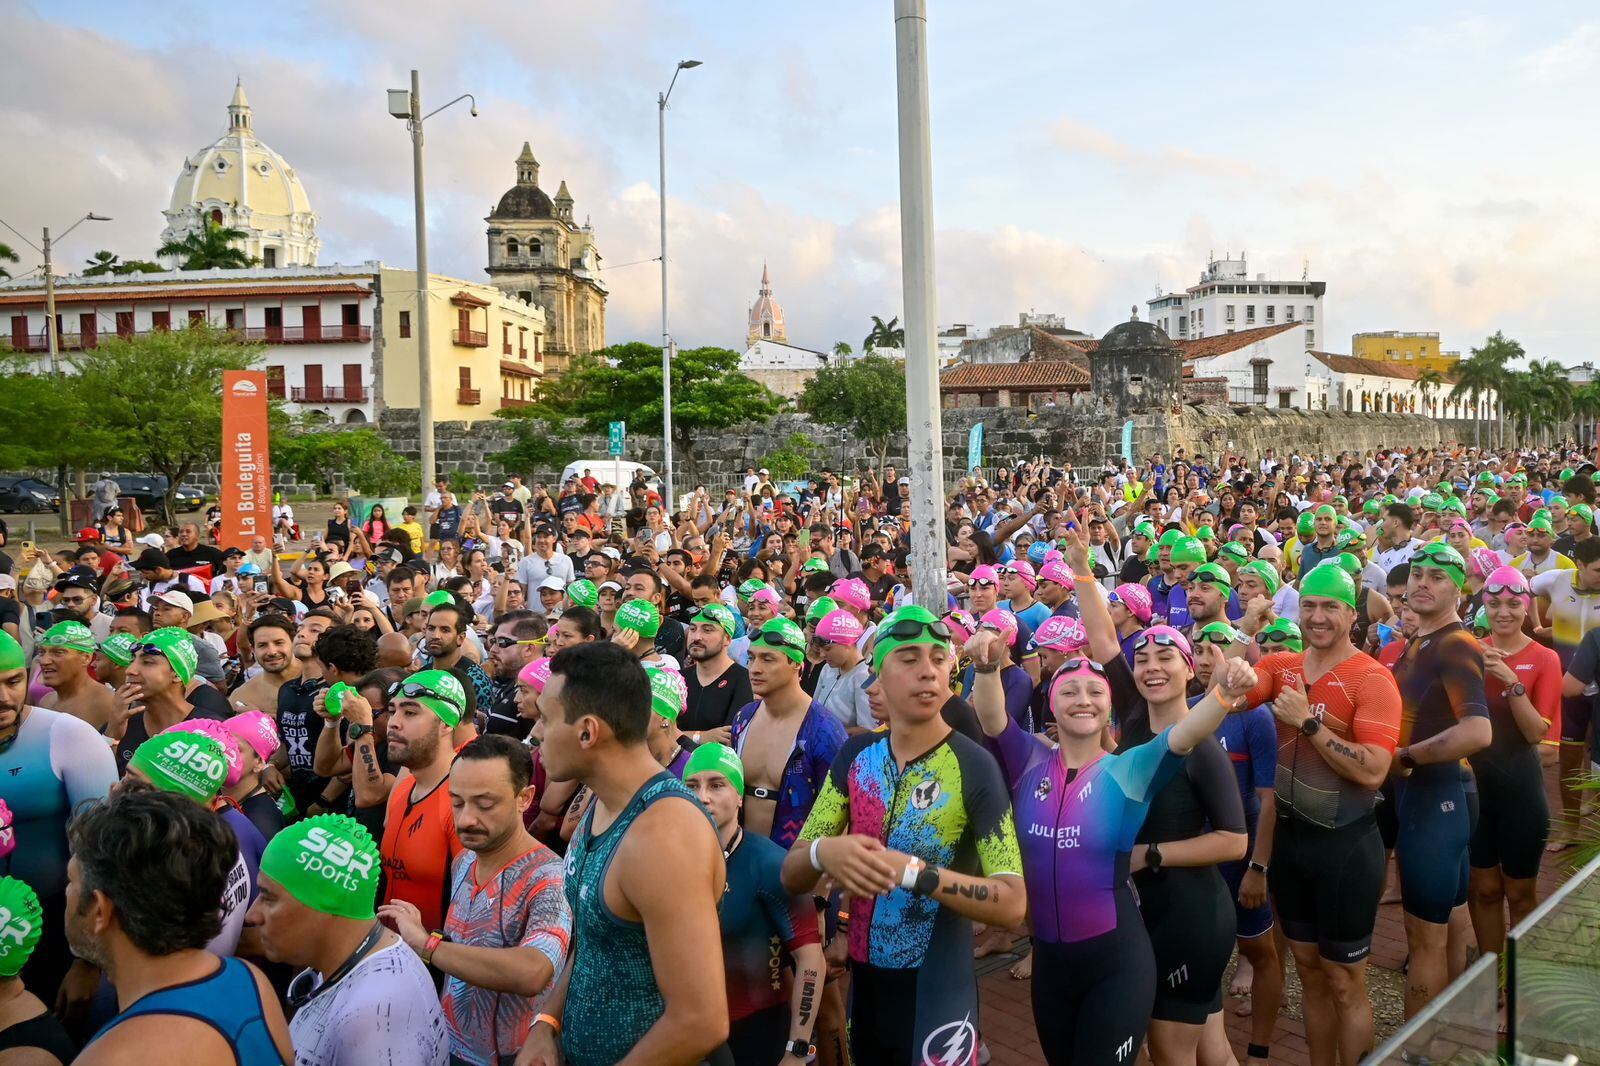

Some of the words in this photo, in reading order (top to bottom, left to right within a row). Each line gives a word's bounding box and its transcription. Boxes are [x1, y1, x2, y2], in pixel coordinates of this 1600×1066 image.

[235, 432, 256, 511] Bodeguita
[238, 516, 256, 535] La
[620, 612, 645, 627] sports
[623, 603, 651, 623] SBR
[283, 726, 308, 737] SOLO
[285, 736, 312, 755] X
[156, 752, 216, 788] TRIATHLON
[288, 754, 312, 767] HOY
[160, 761, 207, 791] COLOMBIA
[1028, 822, 1080, 839] JULIETH
[1057, 837, 1080, 849] COL
[298, 827, 373, 880] SBR
[296, 850, 360, 892] sports
[234, 883, 248, 908] YOU
[799, 981, 816, 1027] 557
